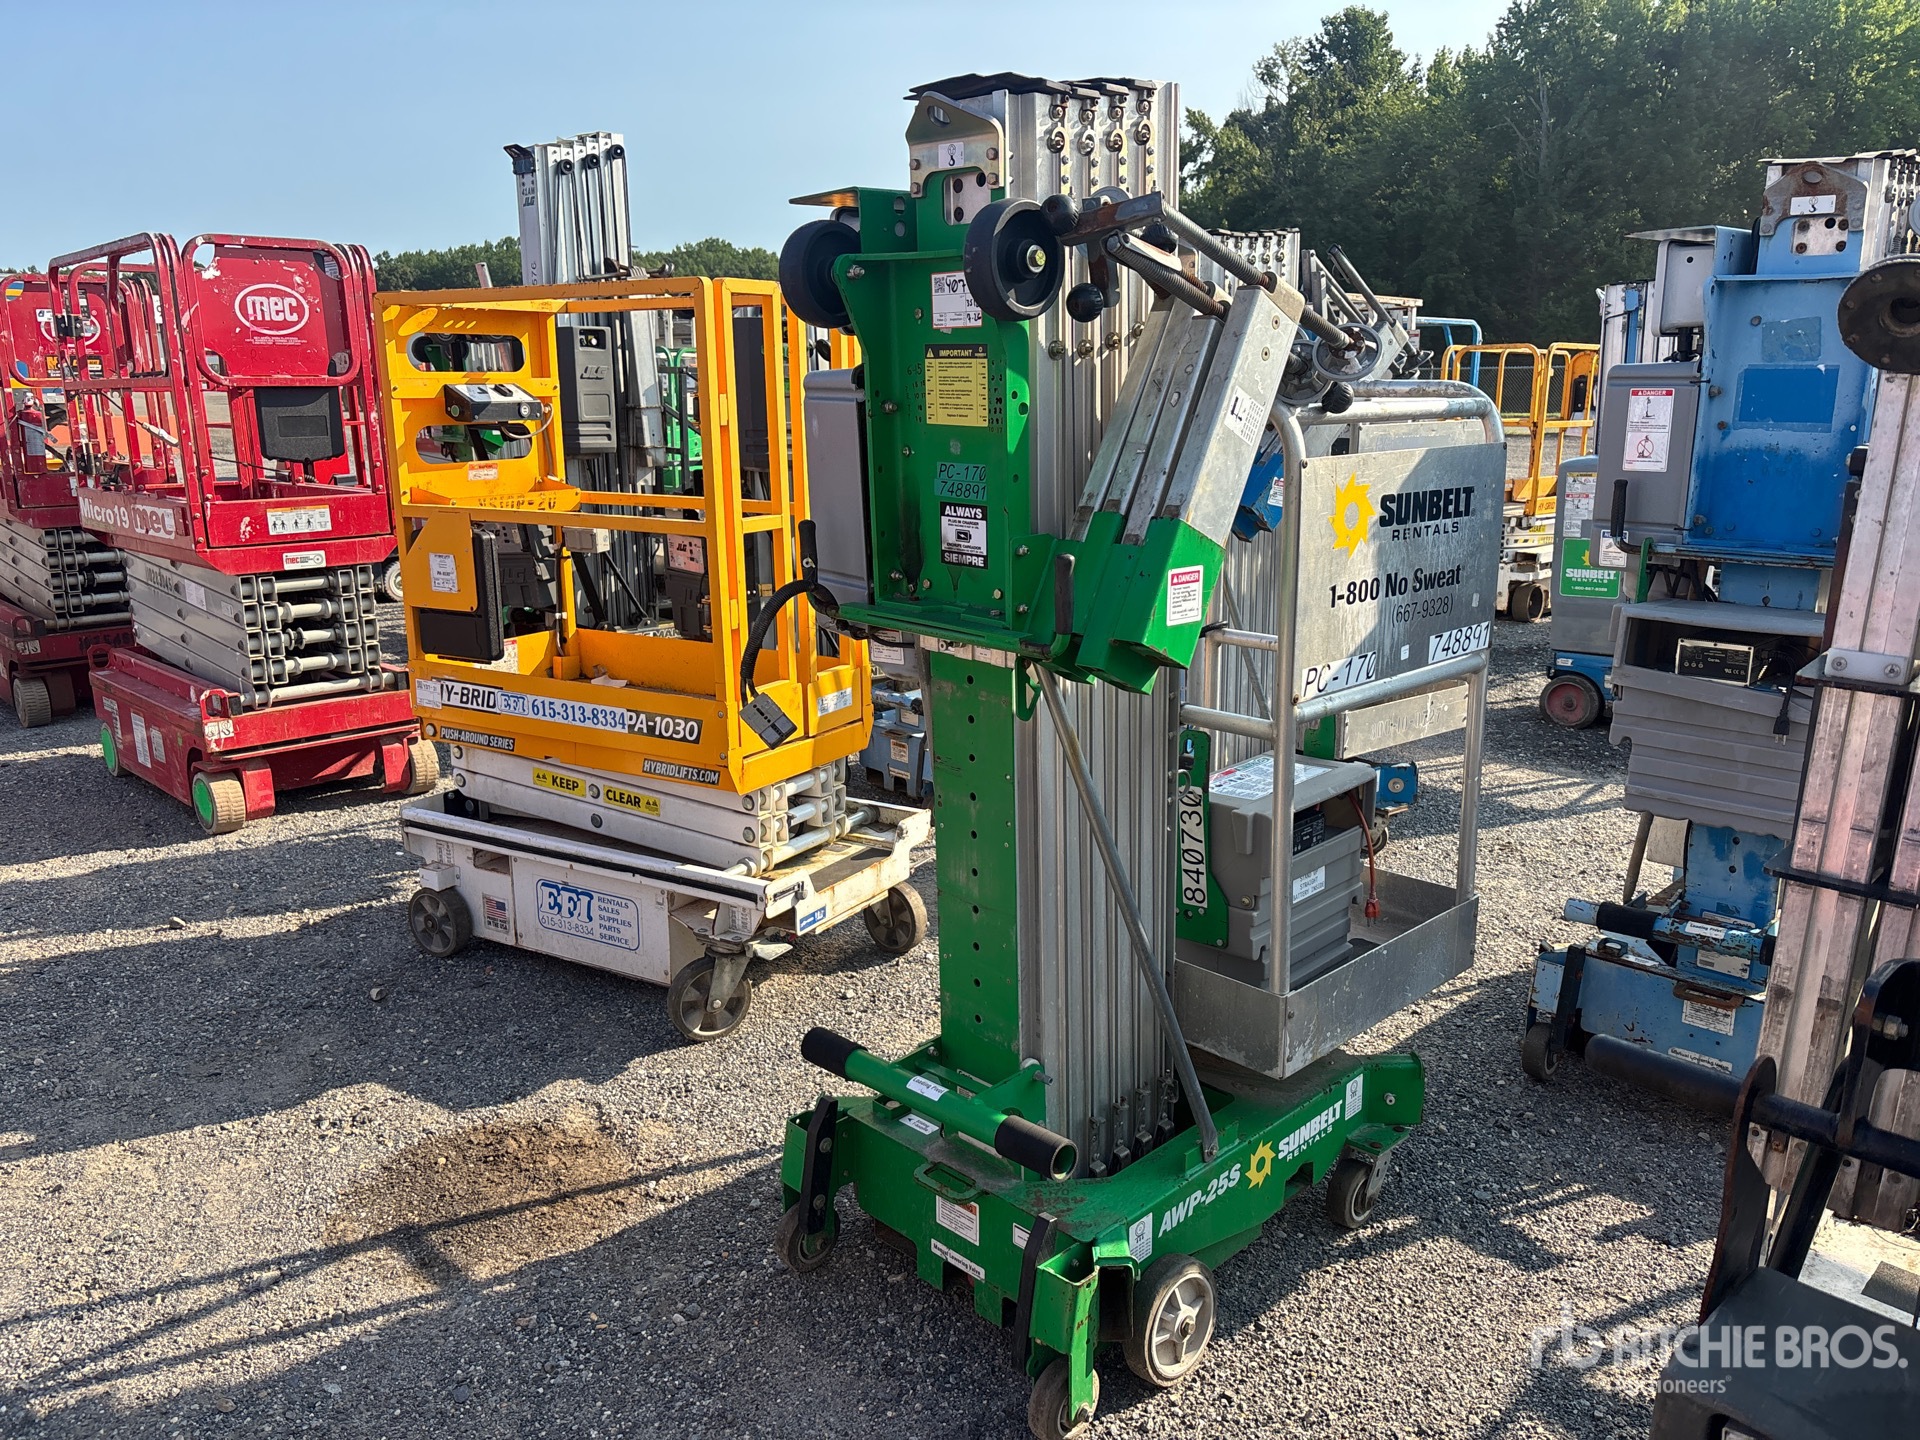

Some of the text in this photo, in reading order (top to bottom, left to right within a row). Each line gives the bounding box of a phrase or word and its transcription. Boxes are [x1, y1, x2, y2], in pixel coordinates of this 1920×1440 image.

[939, 349, 973, 357] IMPORTANT
[938, 463, 987, 482] PC-170
[940, 480, 987, 500] 748891
[79, 497, 129, 529] Micro19
[944, 505, 983, 519] ALWAYS
[1379, 486, 1475, 527] SUNBELT
[1392, 521, 1460, 541] RENTALS
[944, 552, 985, 567] SIEMPRE
[1178, 572, 1199, 583] DANGER
[1565, 568, 1617, 580] SUNBELT
[1329, 564, 1461, 608] 1-800 No Sweat
[1391, 593, 1454, 628] (667-9328)
[1431, 623, 1490, 661] 748891
[1303, 651, 1377, 697] PC-170
[531, 698, 627, 730] 615-313-8334
[627, 711, 699, 741] PA-1030
[441, 727, 514, 751] PUSH-AROUND SERIES
[551, 774, 579, 792] KEEP
[643, 759, 720, 785] HYBRIDLIFTS.COM
[605, 788, 641, 809] CLEAR
[1179, 788, 1206, 904] 840730
[540, 882, 595, 923] EFI
[597, 895, 629, 910] RENTALS
[597, 905, 620, 916] SALES
[541, 914, 595, 937] 615-313-8334
[598, 914, 632, 928] SUPPLIES
[598, 923, 621, 935] PARTS
[599, 932, 630, 946] SERVICE
[1277, 1099, 1343, 1160] SUNBELT
[1286, 1124, 1334, 1162] RENTALS
[1158, 1162, 1241, 1239] AWP-25S
[933, 1242, 981, 1276] Manual Lowering Valve
